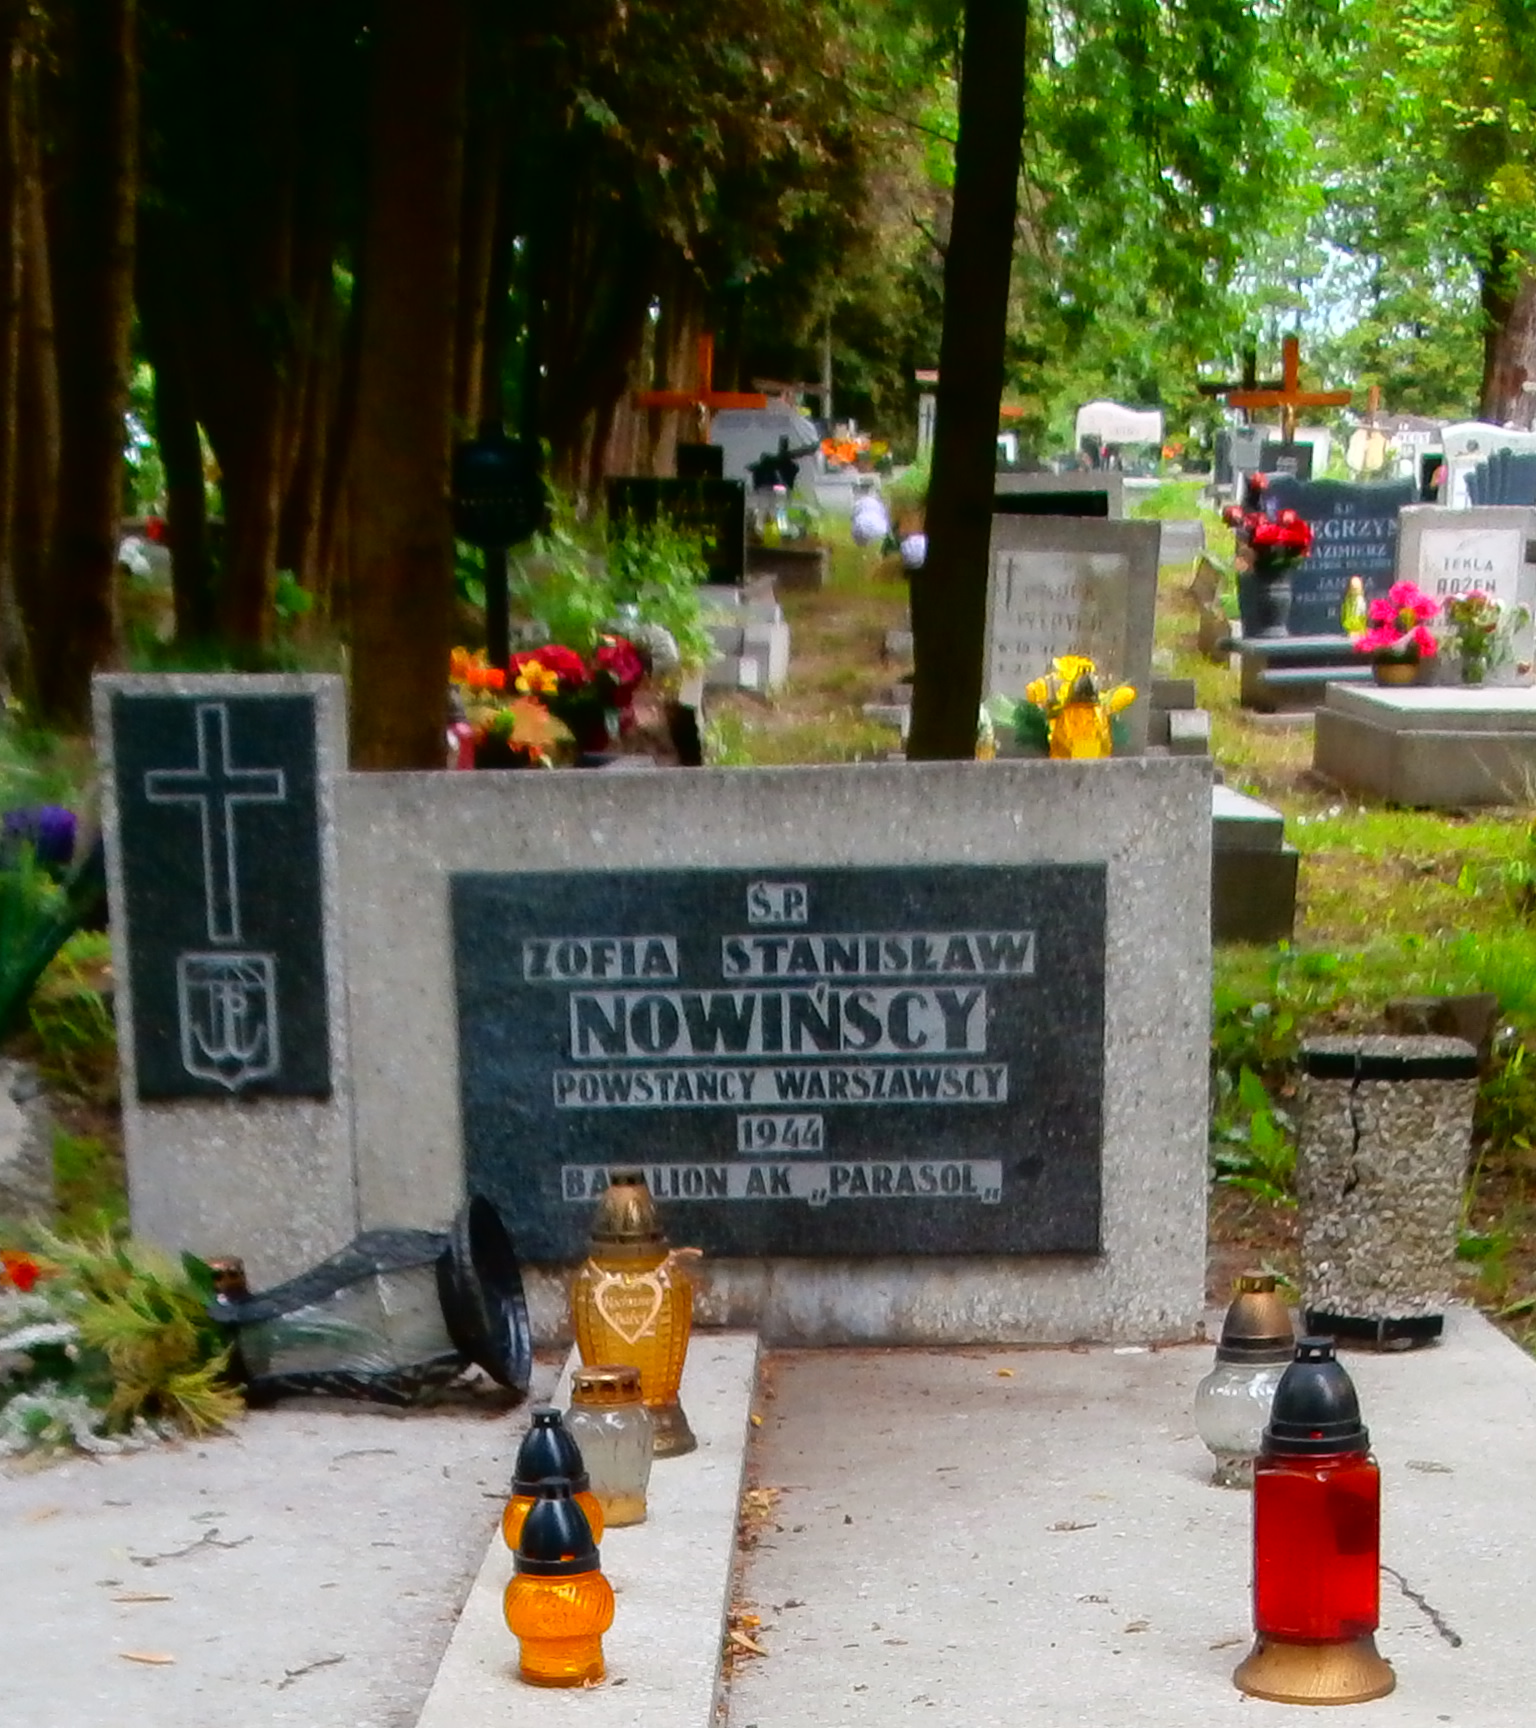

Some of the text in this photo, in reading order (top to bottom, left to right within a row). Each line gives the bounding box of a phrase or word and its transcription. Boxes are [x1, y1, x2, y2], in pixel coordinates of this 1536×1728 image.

[527, 933, 1033, 978] ZOFIA STANISŁAW
[574, 983, 983, 1055] NOWIŃSCY
[772, 1066, 1004, 1101] WARSZAWSCY
[741, 1117, 821, 1149] 1944
[564, 1164, 729, 1199] BALION
[745, 1164, 793, 1196] AK
